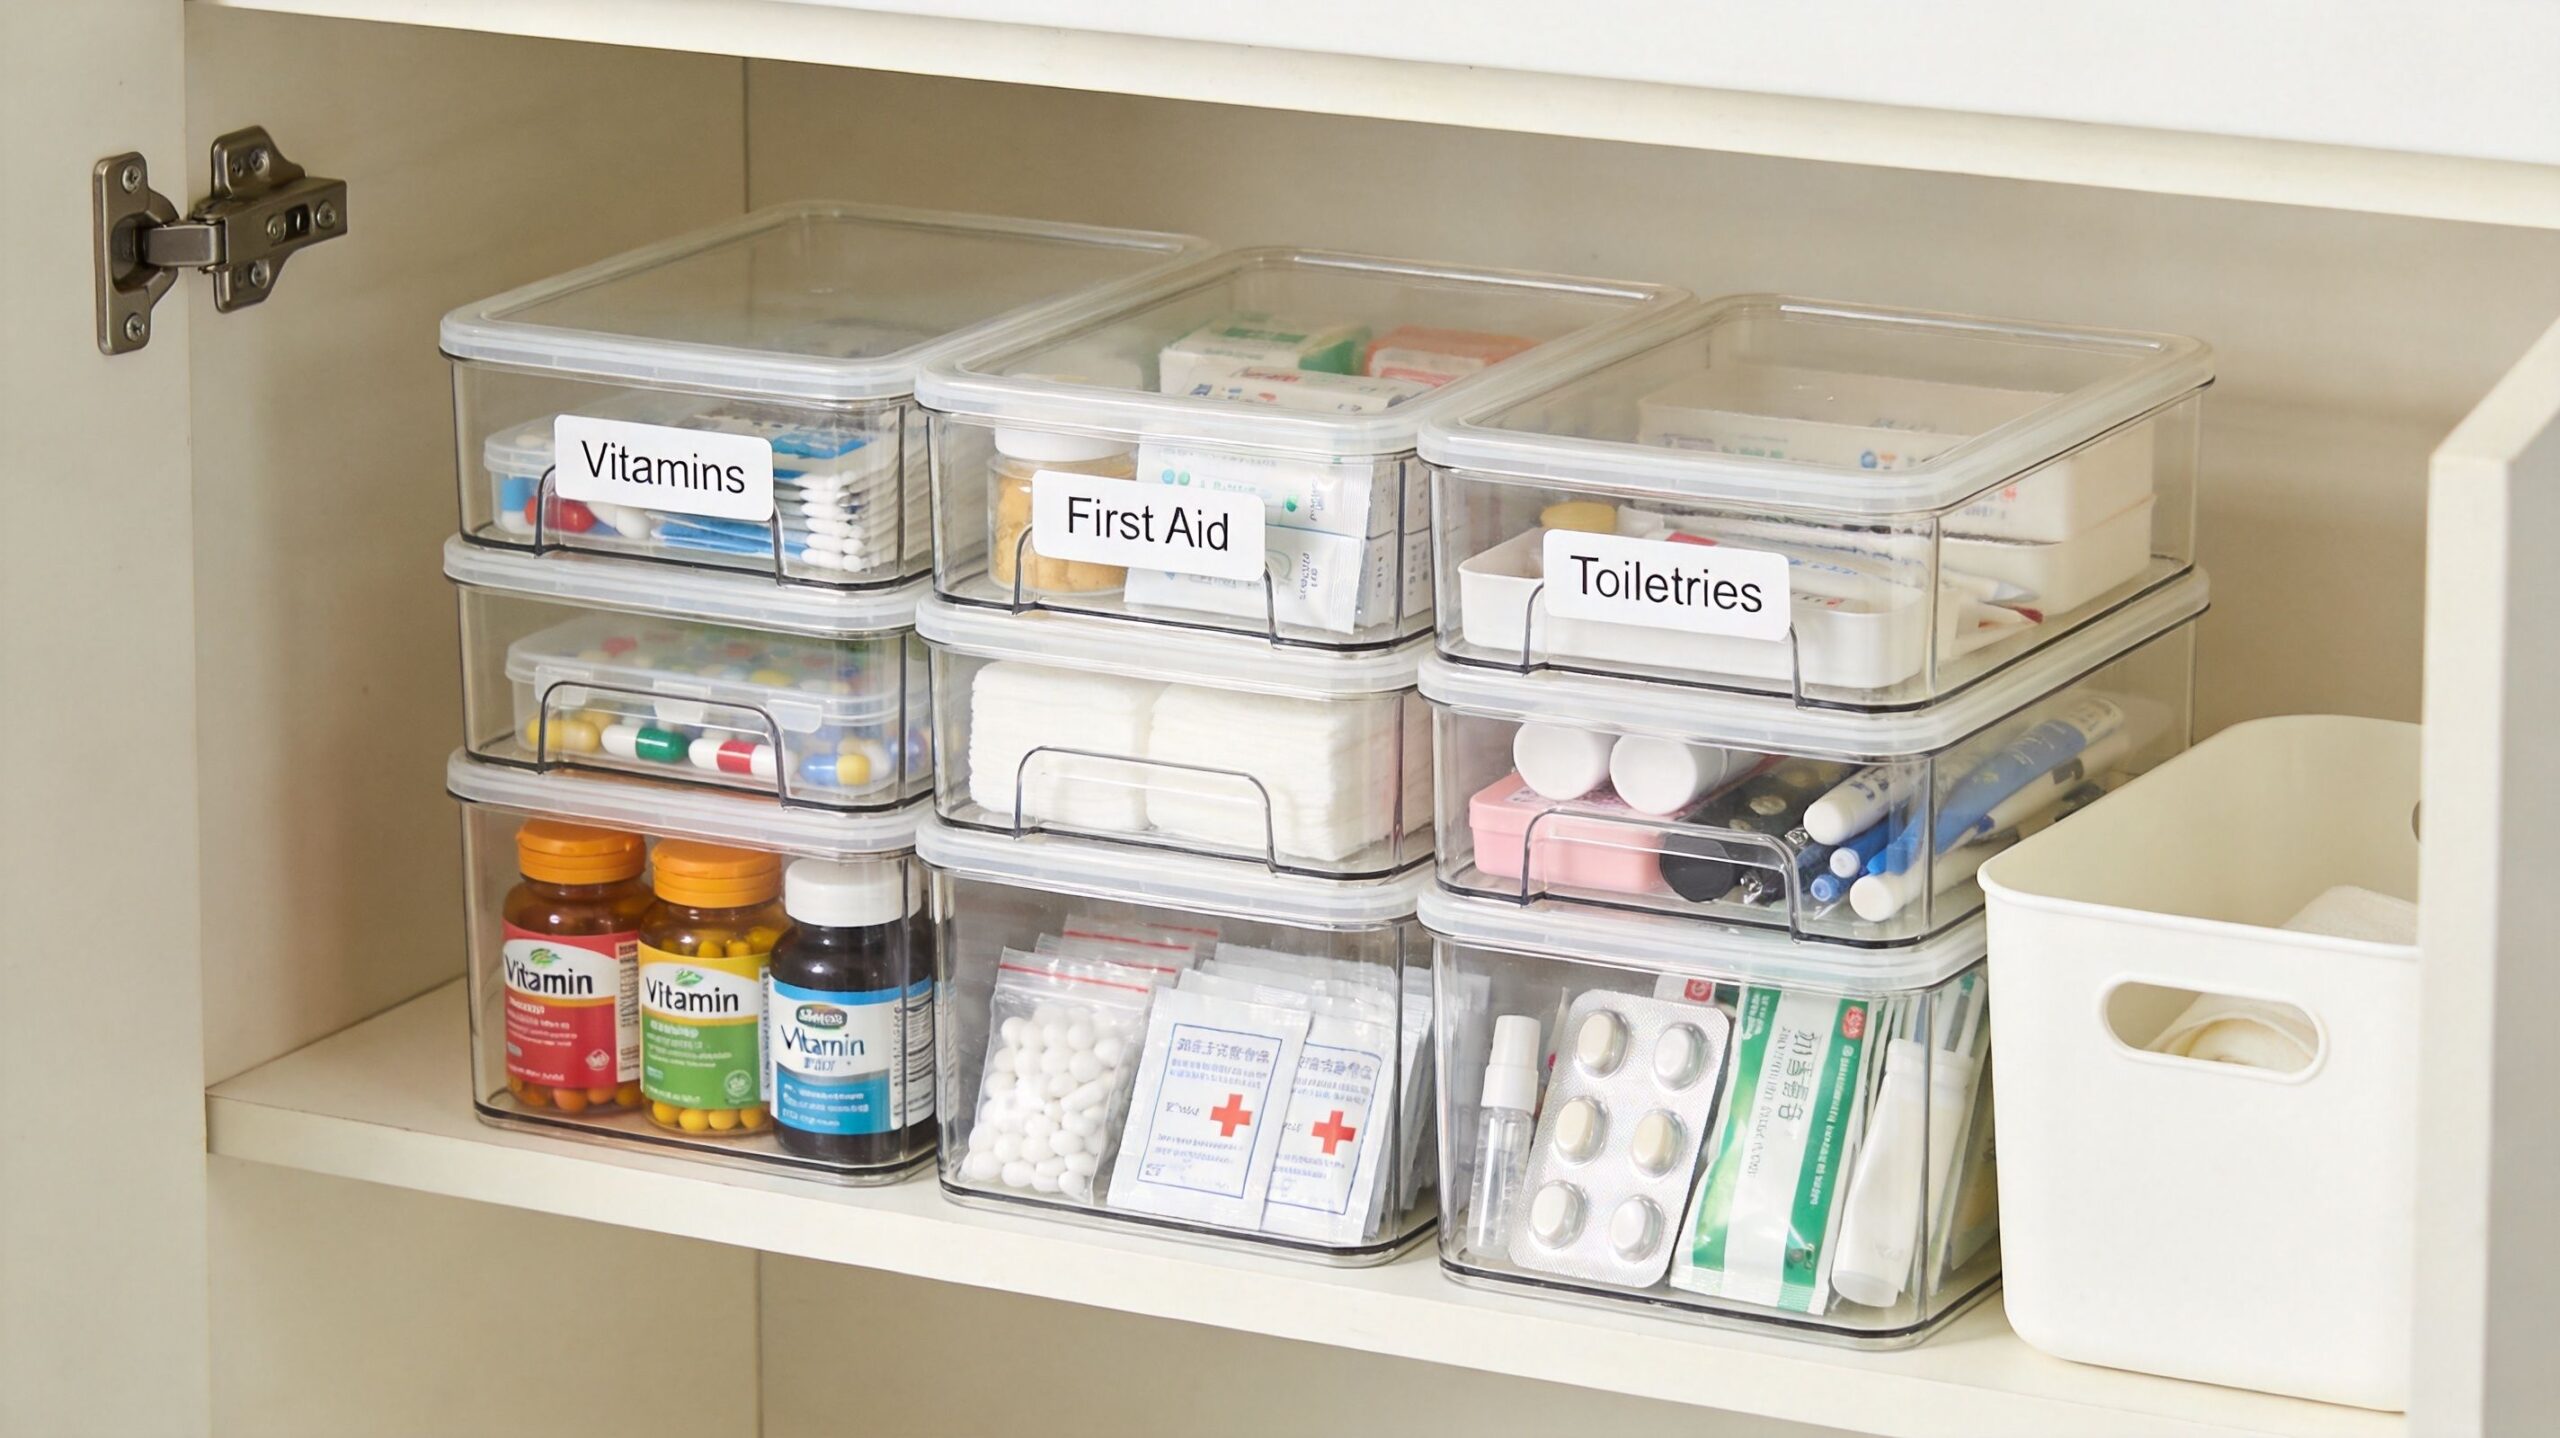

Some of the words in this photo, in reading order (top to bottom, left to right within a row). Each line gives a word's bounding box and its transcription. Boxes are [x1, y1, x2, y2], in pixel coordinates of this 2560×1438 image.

[581, 440, 745, 494] Vitamins
[1068, 496, 1155, 543] First
[1165, 506, 1229, 552] Aid
[1570, 555, 1763, 614] Toiletries
[505, 955, 593, 995] Vitamin
[646, 977, 739, 1013] Vitamin
